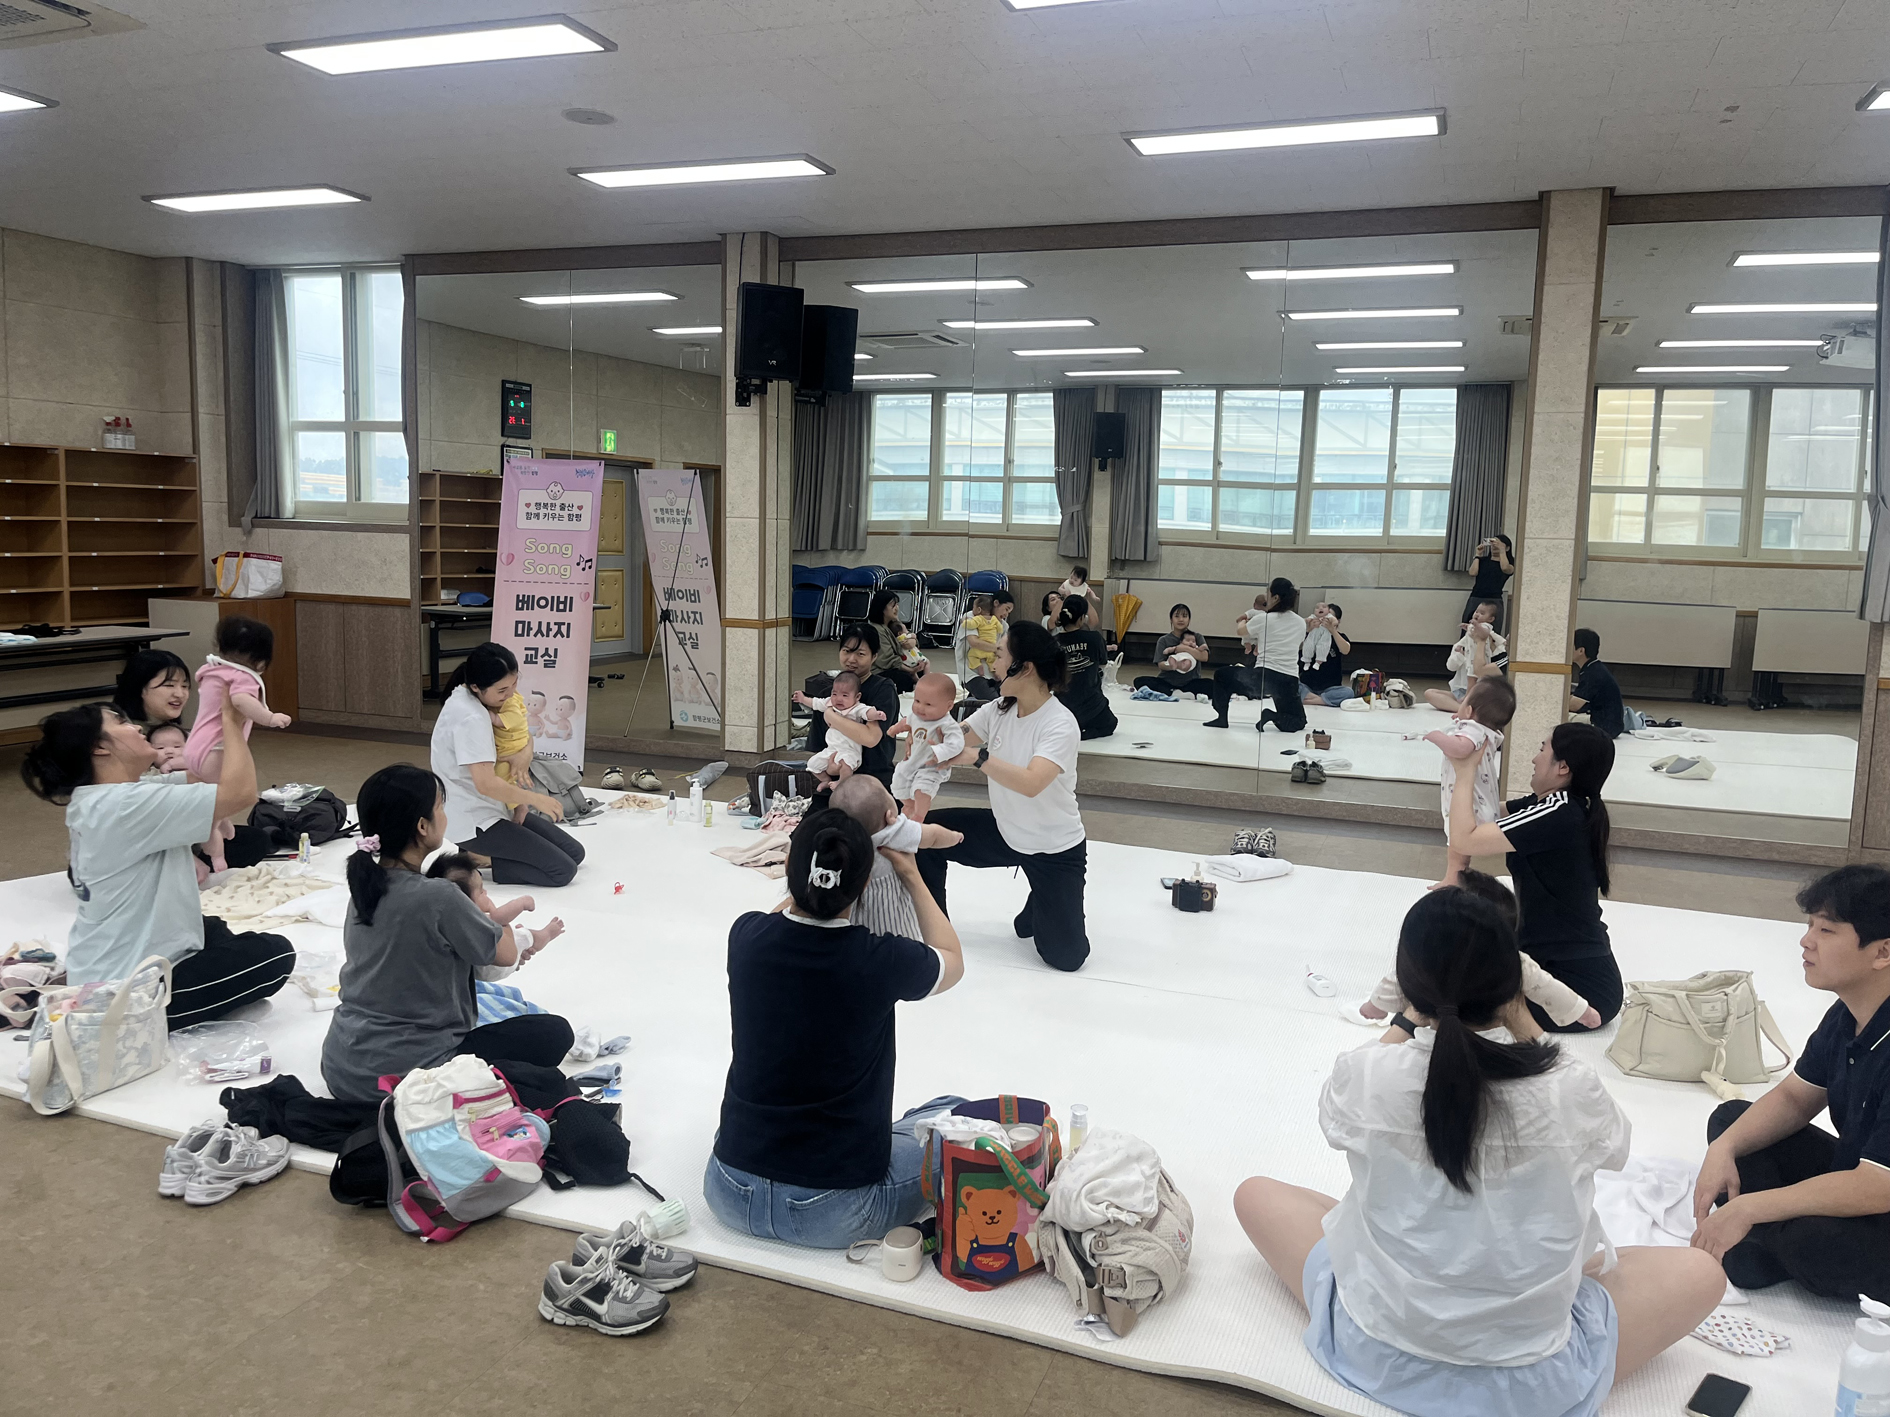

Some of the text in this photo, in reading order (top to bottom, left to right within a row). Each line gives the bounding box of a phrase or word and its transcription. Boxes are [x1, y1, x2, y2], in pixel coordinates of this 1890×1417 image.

[534, 502, 557, 511] 행복한
[525, 512, 582, 522] 함께 키우는 함평
[524, 537, 573, 558] Song
[659, 539, 691, 557] Song
[523, 558, 572, 579] Song
[662, 557, 694, 575] Song
[514, 593, 574, 612] 베이비
[662, 586, 701, 604] 베이비
[514, 620, 571, 639] 마사지
[676, 631, 700, 650] 교실
[523, 646, 559, 669] 교실
